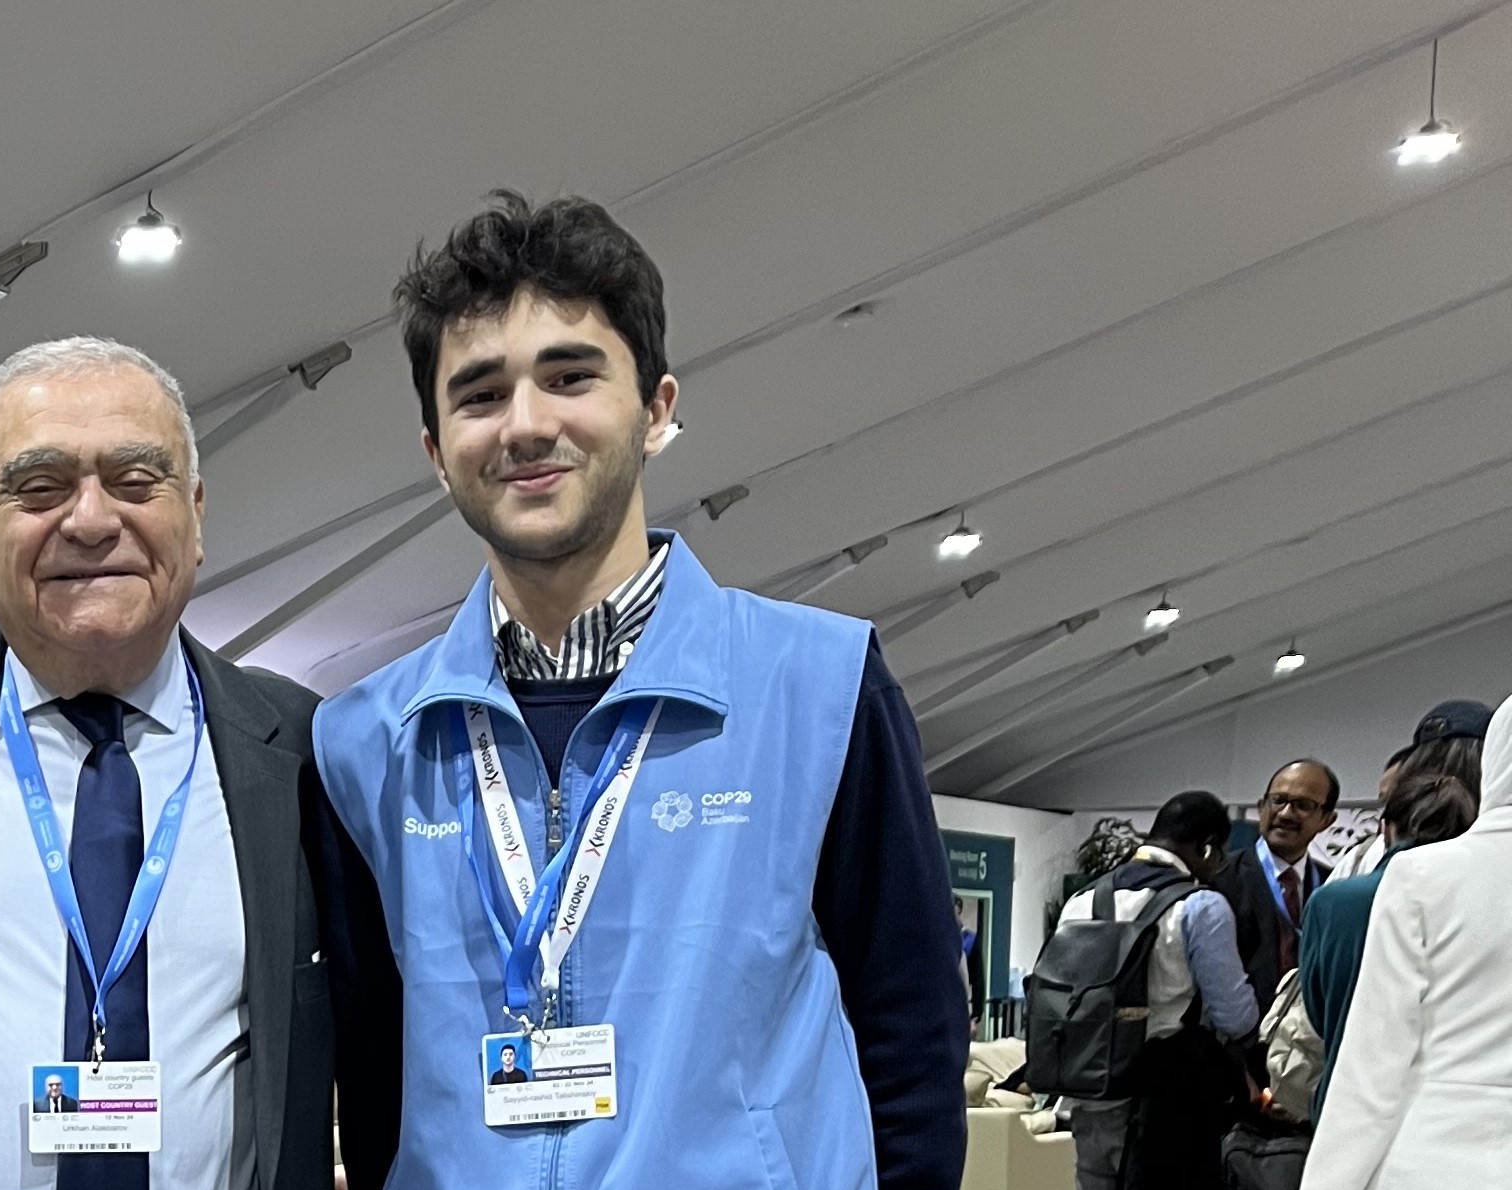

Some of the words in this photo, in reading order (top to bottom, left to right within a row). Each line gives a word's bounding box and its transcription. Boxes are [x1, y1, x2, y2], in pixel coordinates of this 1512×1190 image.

[593, 796, 617, 841] KRONOS
[701, 790, 752, 806] COP29
[495, 803, 516, 845] KRONOS
[979, 851, 987, 880] 5
[567, 873, 590, 920] KRONOS
